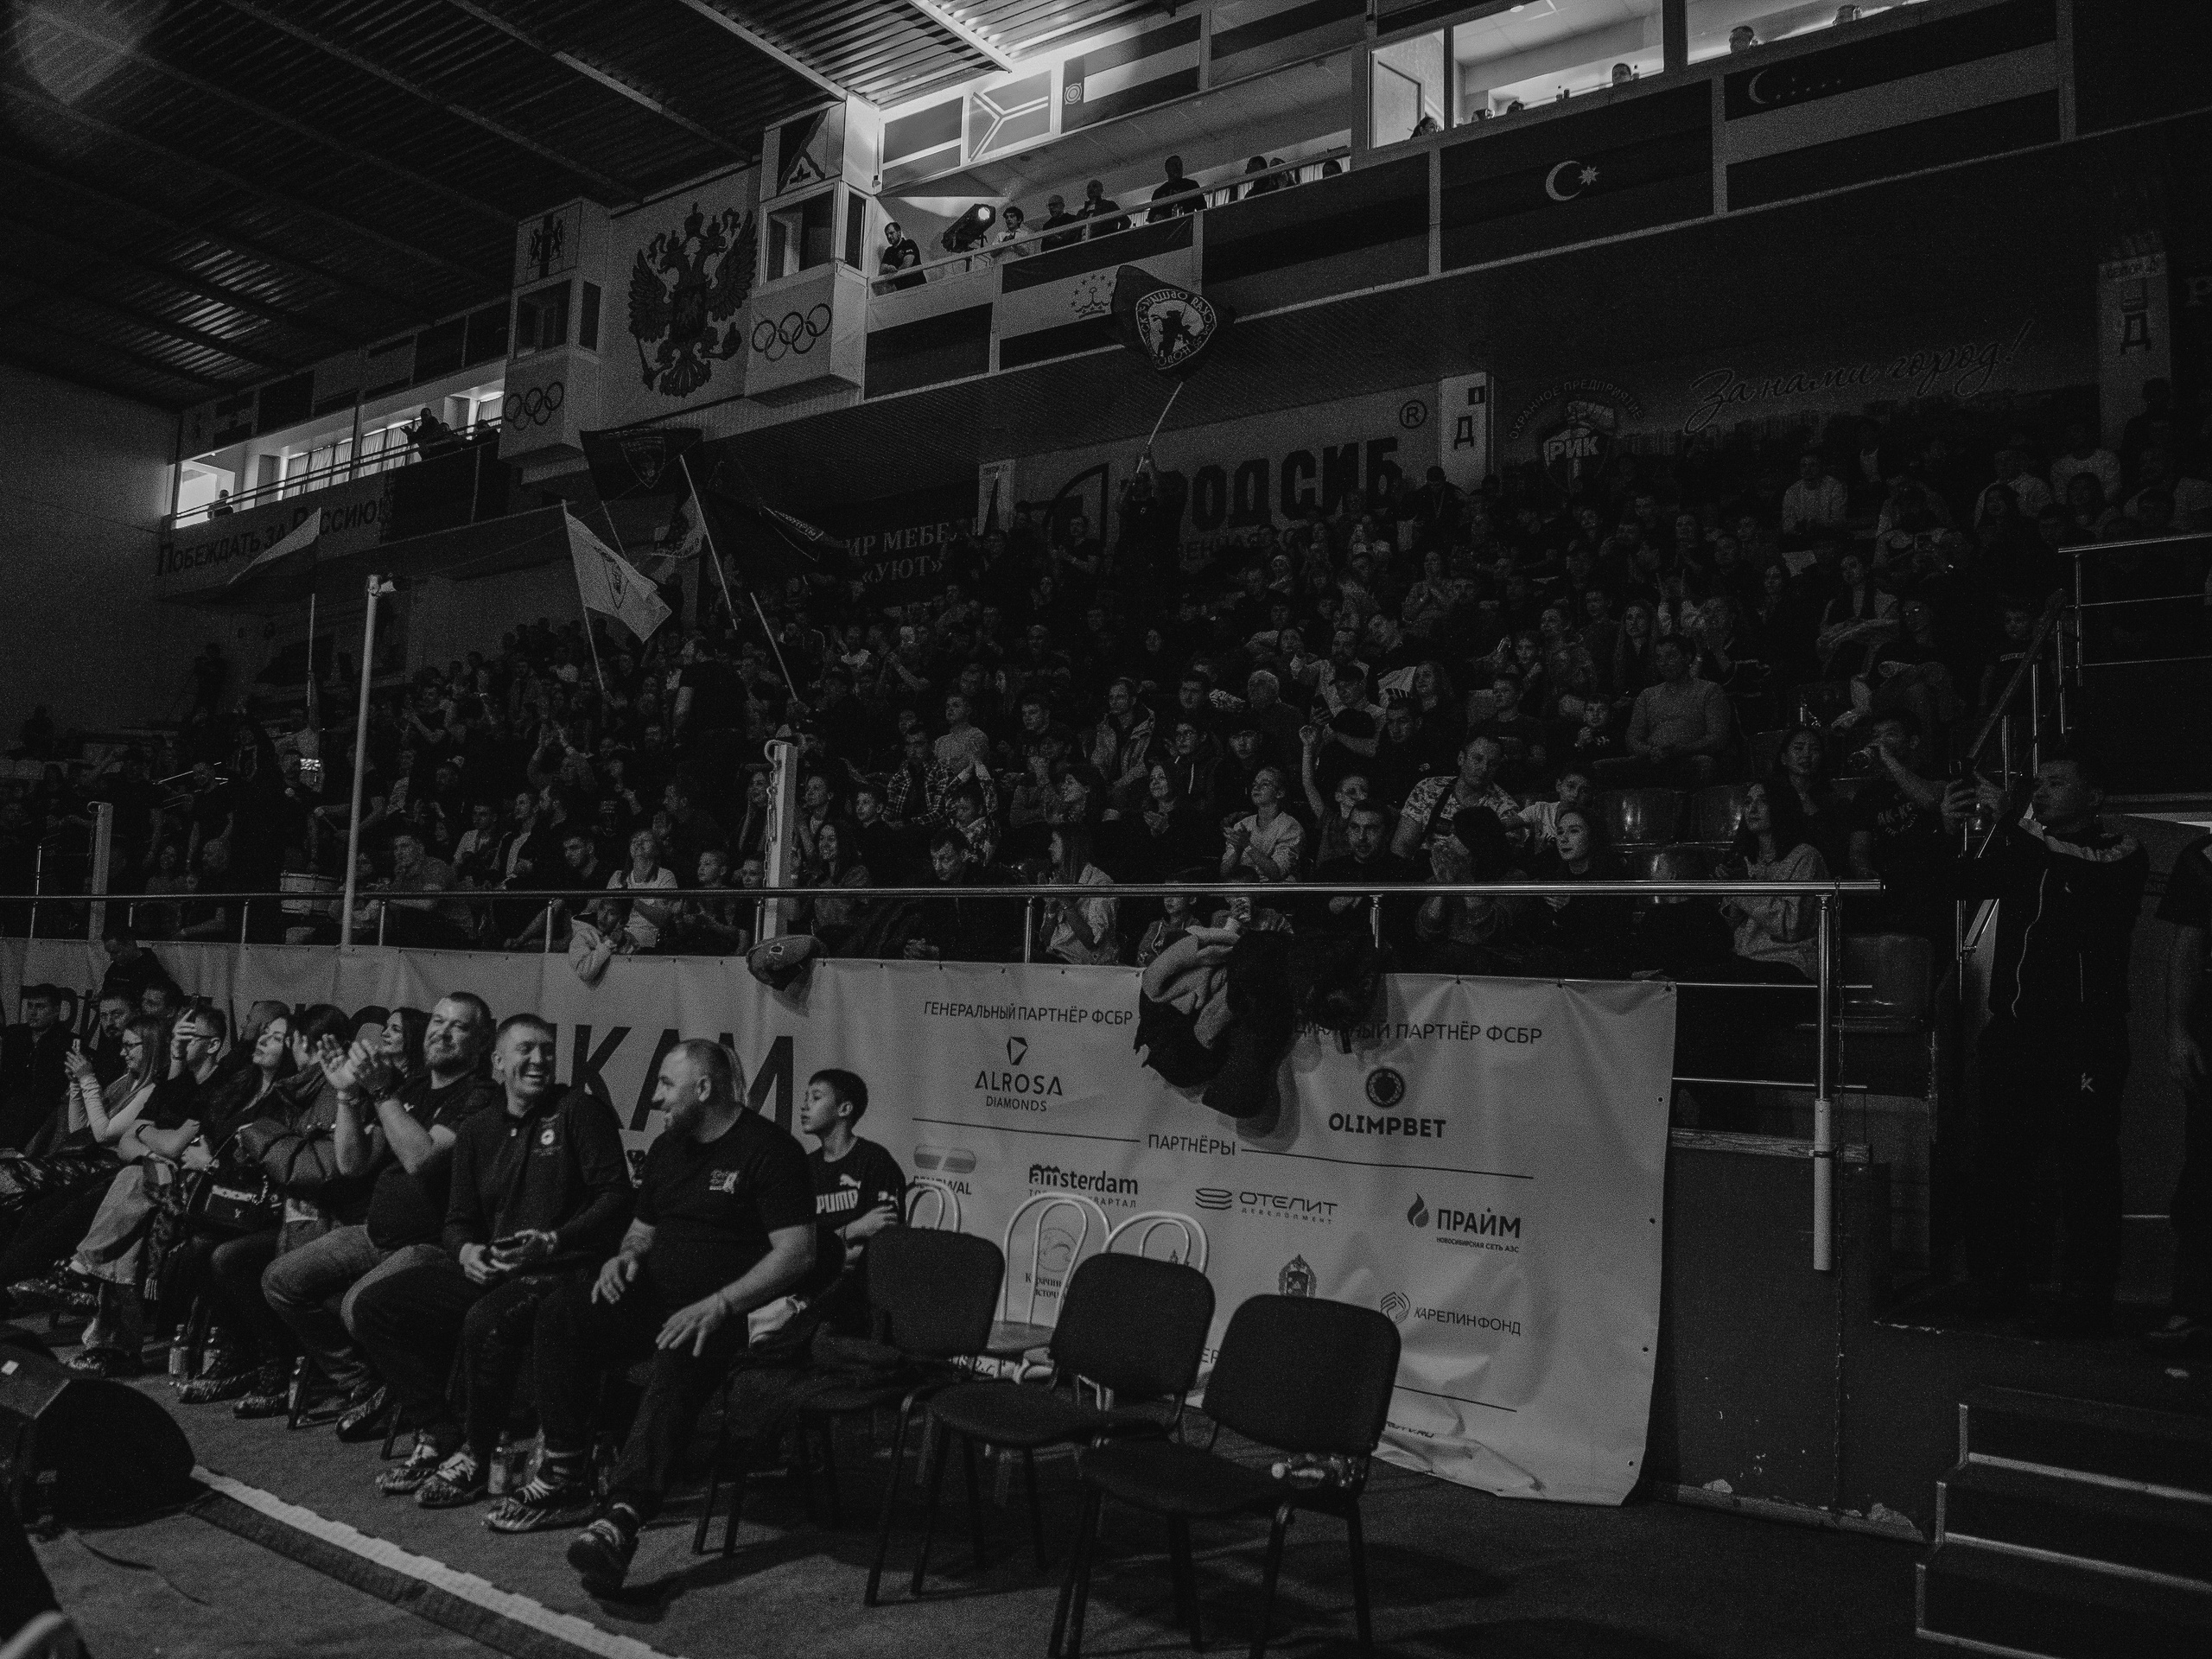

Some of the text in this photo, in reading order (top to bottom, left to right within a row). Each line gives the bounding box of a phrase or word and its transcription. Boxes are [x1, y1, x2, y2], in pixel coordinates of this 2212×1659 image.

[1885, 319, 2036, 399] город!
[1510, 378, 1644, 440] ОХРАННОЕ ПРЕДПРИЯТИЕ
[1548, 435, 1600, 462] РИК
[1121, 436, 1402, 533] ОДСИБ
[293, 498, 387, 537] РССИЮ!
[844, 521, 969, 558] ИР МЕБЕ
[861, 554, 944, 583] «УЮТ»
[923, 1000, 1134, 1027] ГЕНЕРАЛЬНЫЙ ПАРТНЁР ФСБР
[1396, 1020, 1482, 1042] ПАРТНЁР
[1485, 1025, 1543, 1045] ФСБР
[974, 1069, 1064, 1097] ALROSA
[984, 1095, 1048, 1114] DIAMONDS
[1328, 1111, 1447, 1139] OLIMPBET
[1147, 1133, 1237, 1156] ПАРТНЁРЫ
[1090, 1194, 1137, 1209] ВАРТАЛ
[1239, 1191, 1339, 1217] ОТЕЛИТ
[1437, 1207, 1522, 1239] ПРАЙМ
[1436, 1236, 1520, 1254] НОВОСИБИРСКАЯ СЕТЬ АЗС
[1414, 1306, 1522, 1338] КАРЕЛИНФОНД
